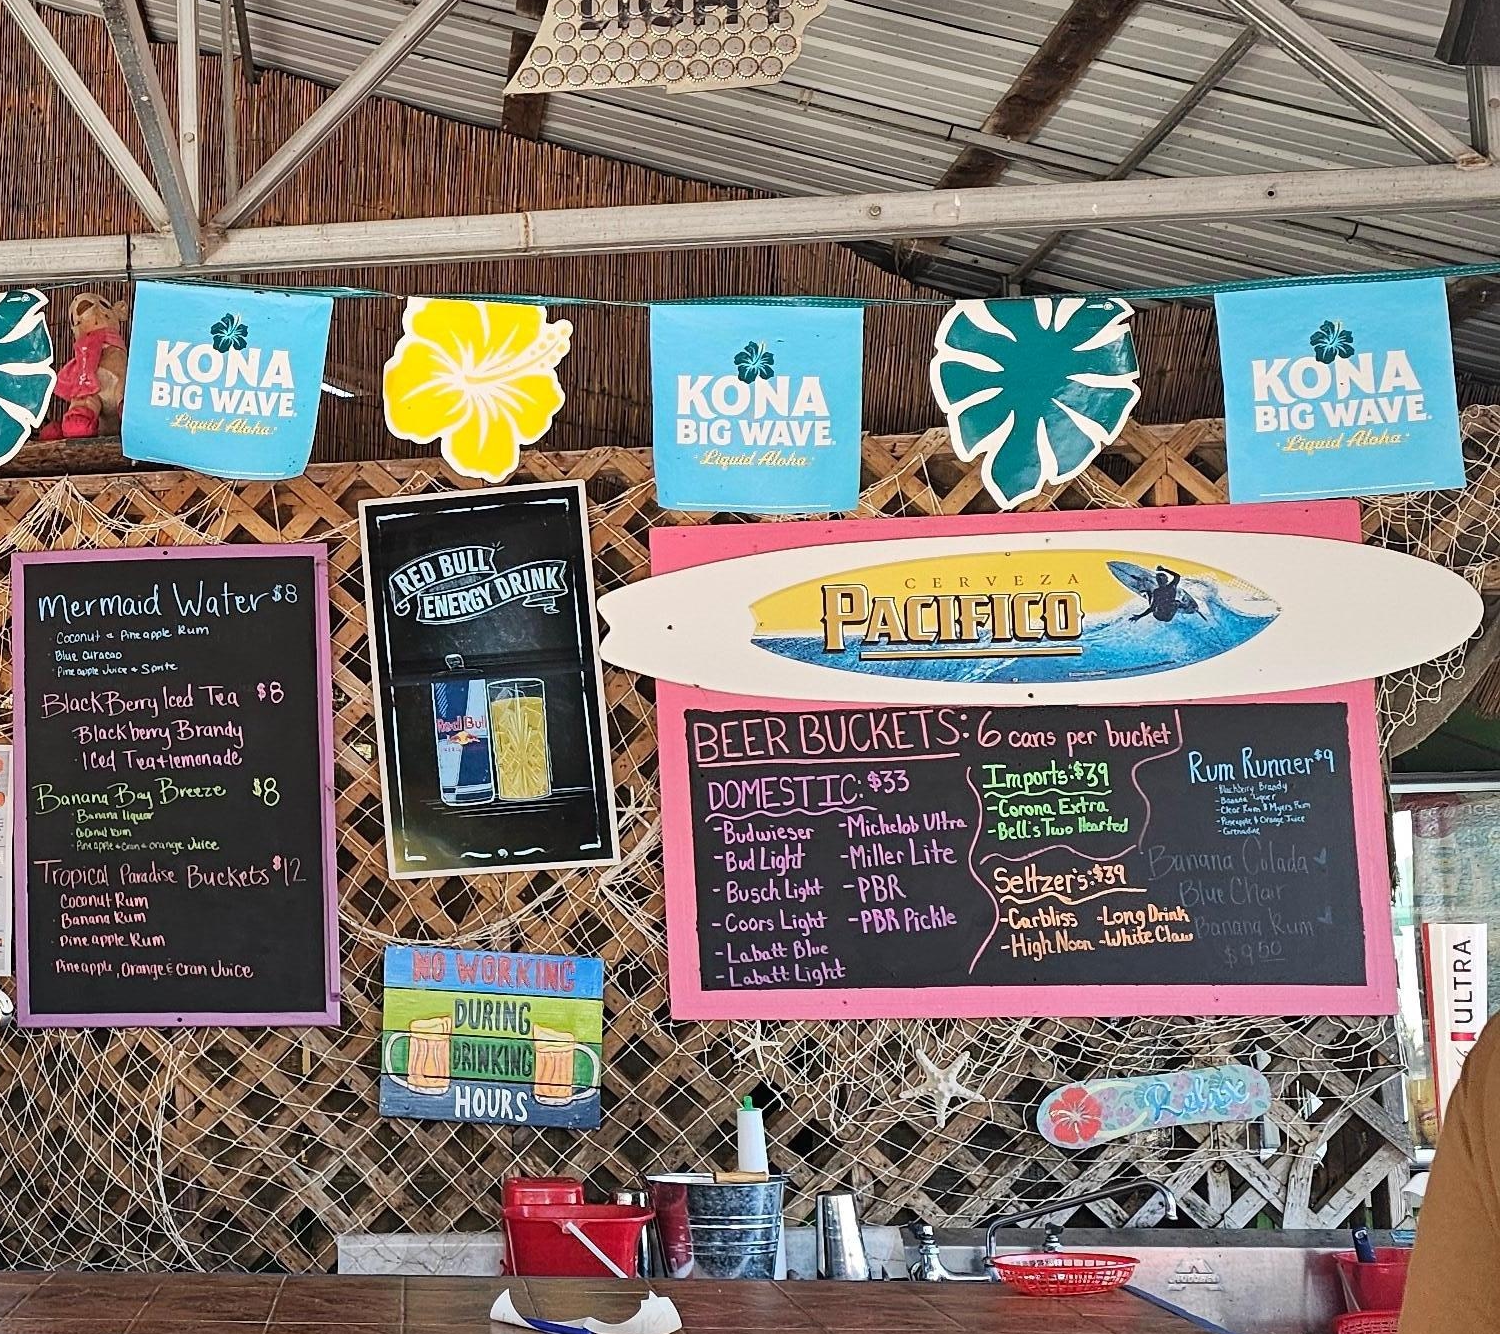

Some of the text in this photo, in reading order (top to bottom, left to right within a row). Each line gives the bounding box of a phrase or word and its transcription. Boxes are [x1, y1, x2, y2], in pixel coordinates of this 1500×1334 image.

[154, 341, 291, 388] KONA
[1251, 350, 1422, 403] KONA
[150, 381, 297, 417] BIG WAVE
[676, 375, 828, 418] KONA
[1254, 393, 1432, 433] BIG WAVE
[676, 419, 835, 446] BIG WAVE
[1283, 429, 1402, 453] Liquid Aloha
[395, 549, 490, 595] RED BULL
[904, 574, 1081, 589] CERVEZA
[38, 580, 299, 624] Mermaid Water $8
[422, 567, 561, 619] ENERGY DRINK
[820, 583, 1086, 653] PACIFICO
[56, 624, 210, 645] Coconut Rum
[55, 650, 79, 662] Blue
[102, 663, 128, 676] Juice
[162, 681, 285, 710] Iced Tea $8
[171, 719, 244, 749] Brandy
[436, 716, 463, 733] Red
[693, 709, 1172, 763] BEER BUCKETS: 6 cans per bucket
[1073, 760, 1111, 788] $39
[1188, 746, 1336, 784] Rum Runner $9
[32, 777, 281, 815] Banana Bay Breeze $8
[707, 769, 911, 811] DOMESTIC: $33
[998, 798, 1110, 818] Corona Extra
[847, 811, 968, 838] Michelob Ultra
[1041, 818, 1074, 837] Two
[1077, 817, 1130, 834] Hearted
[187, 837, 220, 851] Juice
[849, 838, 958, 870] Miller Lite
[33, 854, 307, 889] Tropical Paradise Buckets $12
[725, 843, 806, 877] Bud Light
[857, 874, 907, 904] PBR
[1093, 864, 1128, 886] $39
[60, 893, 149, 910] Coconut Rum
[726, 878, 825, 904] Busch Light
[60, 911, 147, 930] Banana Rum
[725, 909, 829, 937] Coors Light
[859, 905, 958, 934] PBR Pickle
[1102, 903, 1191, 930] Long Drink
[130, 933, 166, 948] Rum
[1011, 930, 1096, 962] High Noon
[1155, 924, 1194, 944] Claw
[727, 939, 829, 964] Labatt Blue
[211, 960, 254, 979] Juice
[412, 951, 577, 992] NO WORKING
[729, 958, 847, 987] Labatt Light
[1452, 939, 1472, 1026] ULTRA
[454, 998, 532, 1036] DURING
[452, 1042, 533, 1077] DRINKING
[454, 1085, 528, 1123] HOURS
